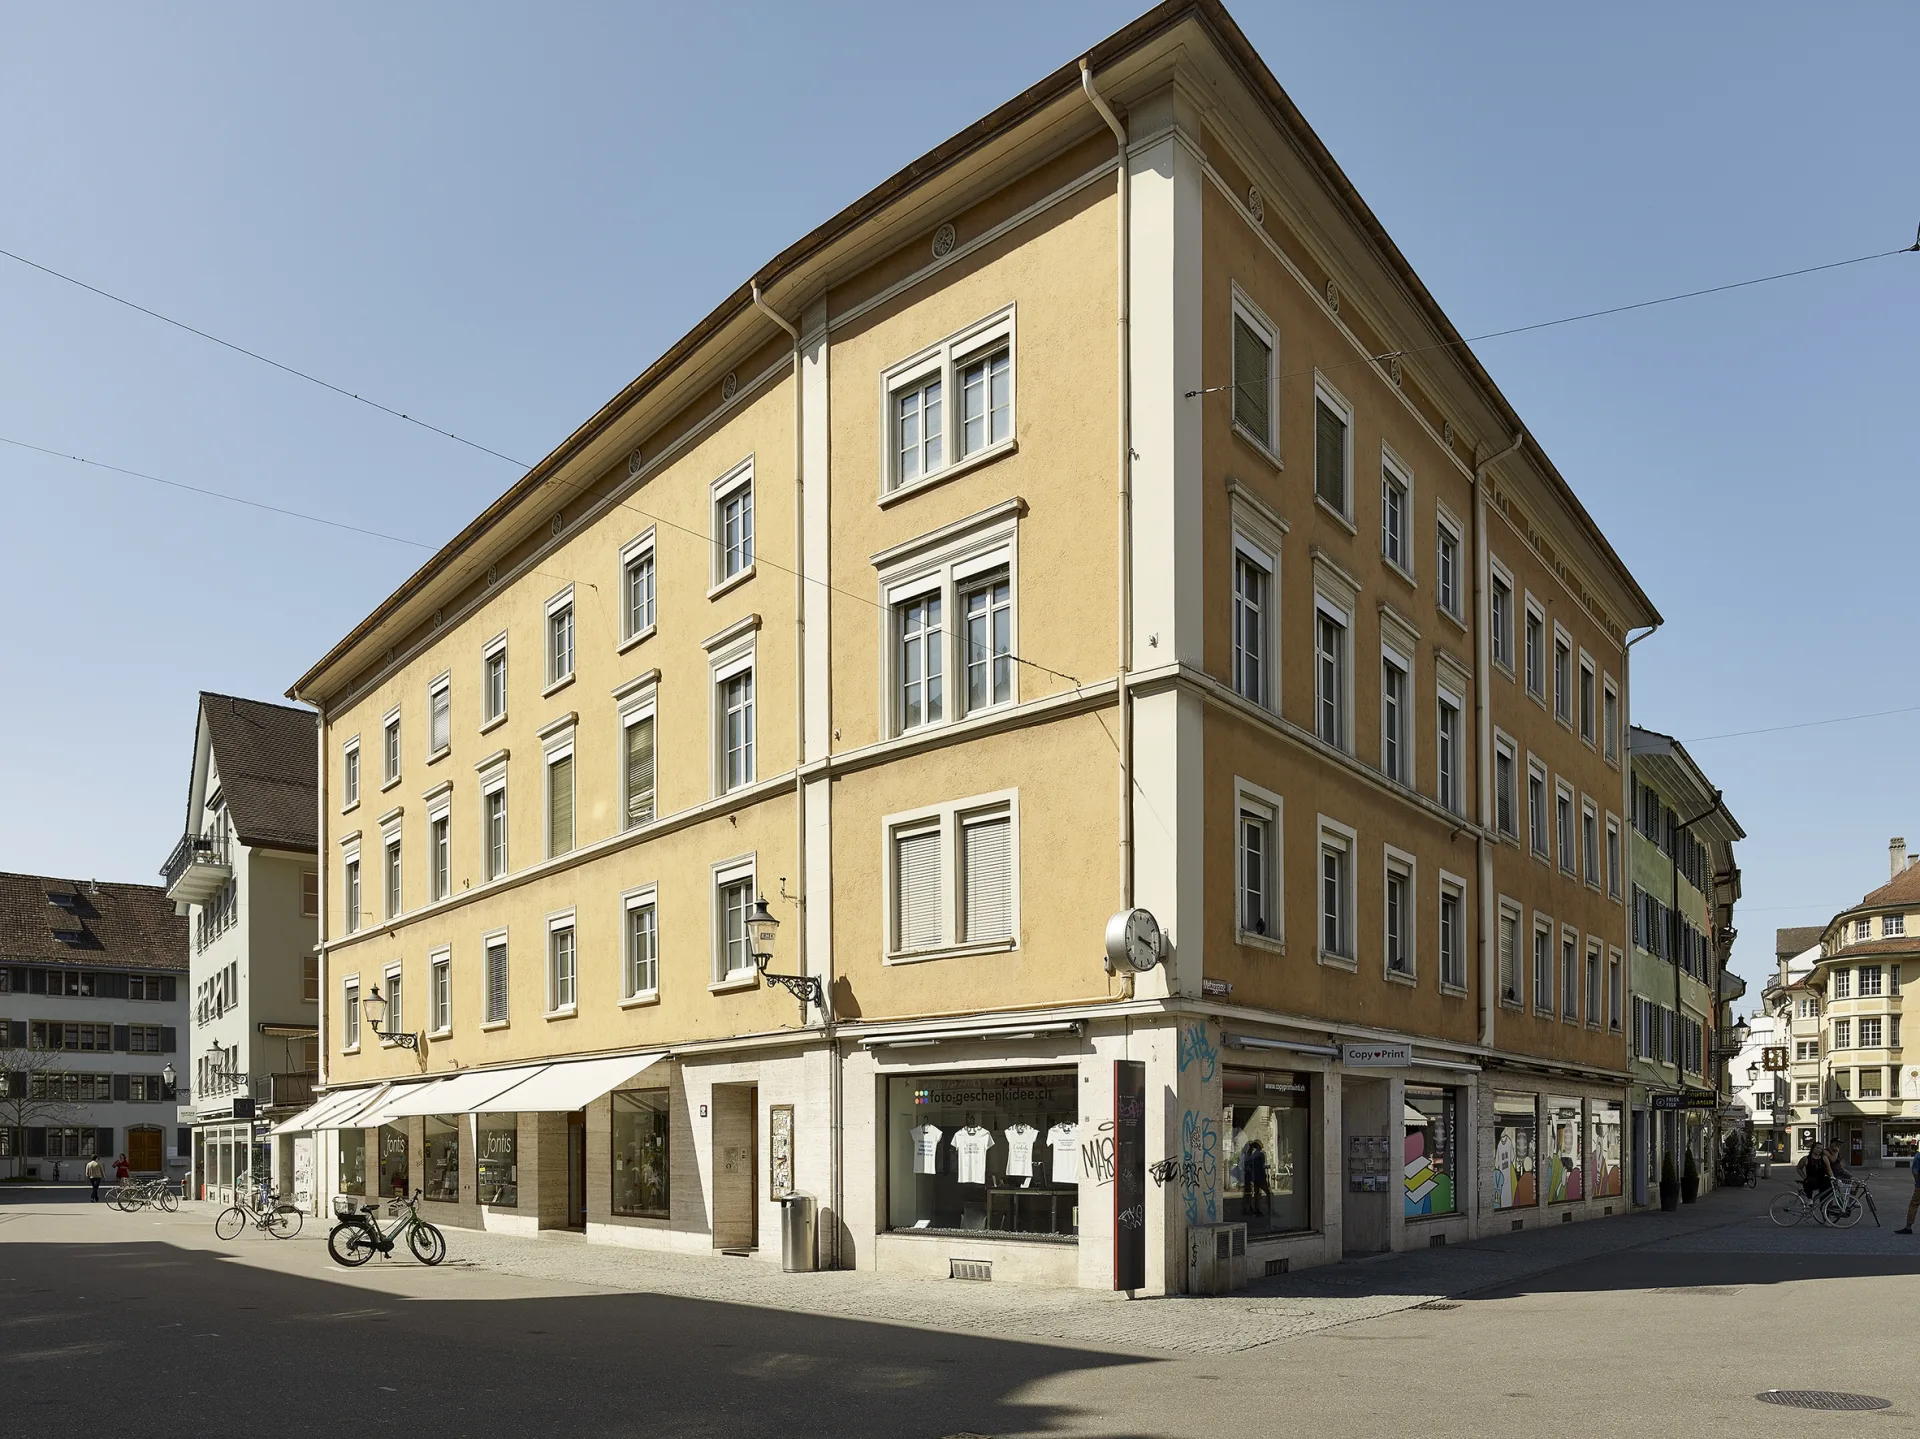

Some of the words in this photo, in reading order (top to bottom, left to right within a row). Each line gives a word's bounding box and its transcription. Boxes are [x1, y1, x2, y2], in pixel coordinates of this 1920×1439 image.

[1349, 1050, 1374, 1060] Copy
[1381, 1050, 1405, 1059] Print
[930, 1087, 1052, 1105] foto-geschenkidee.ch
